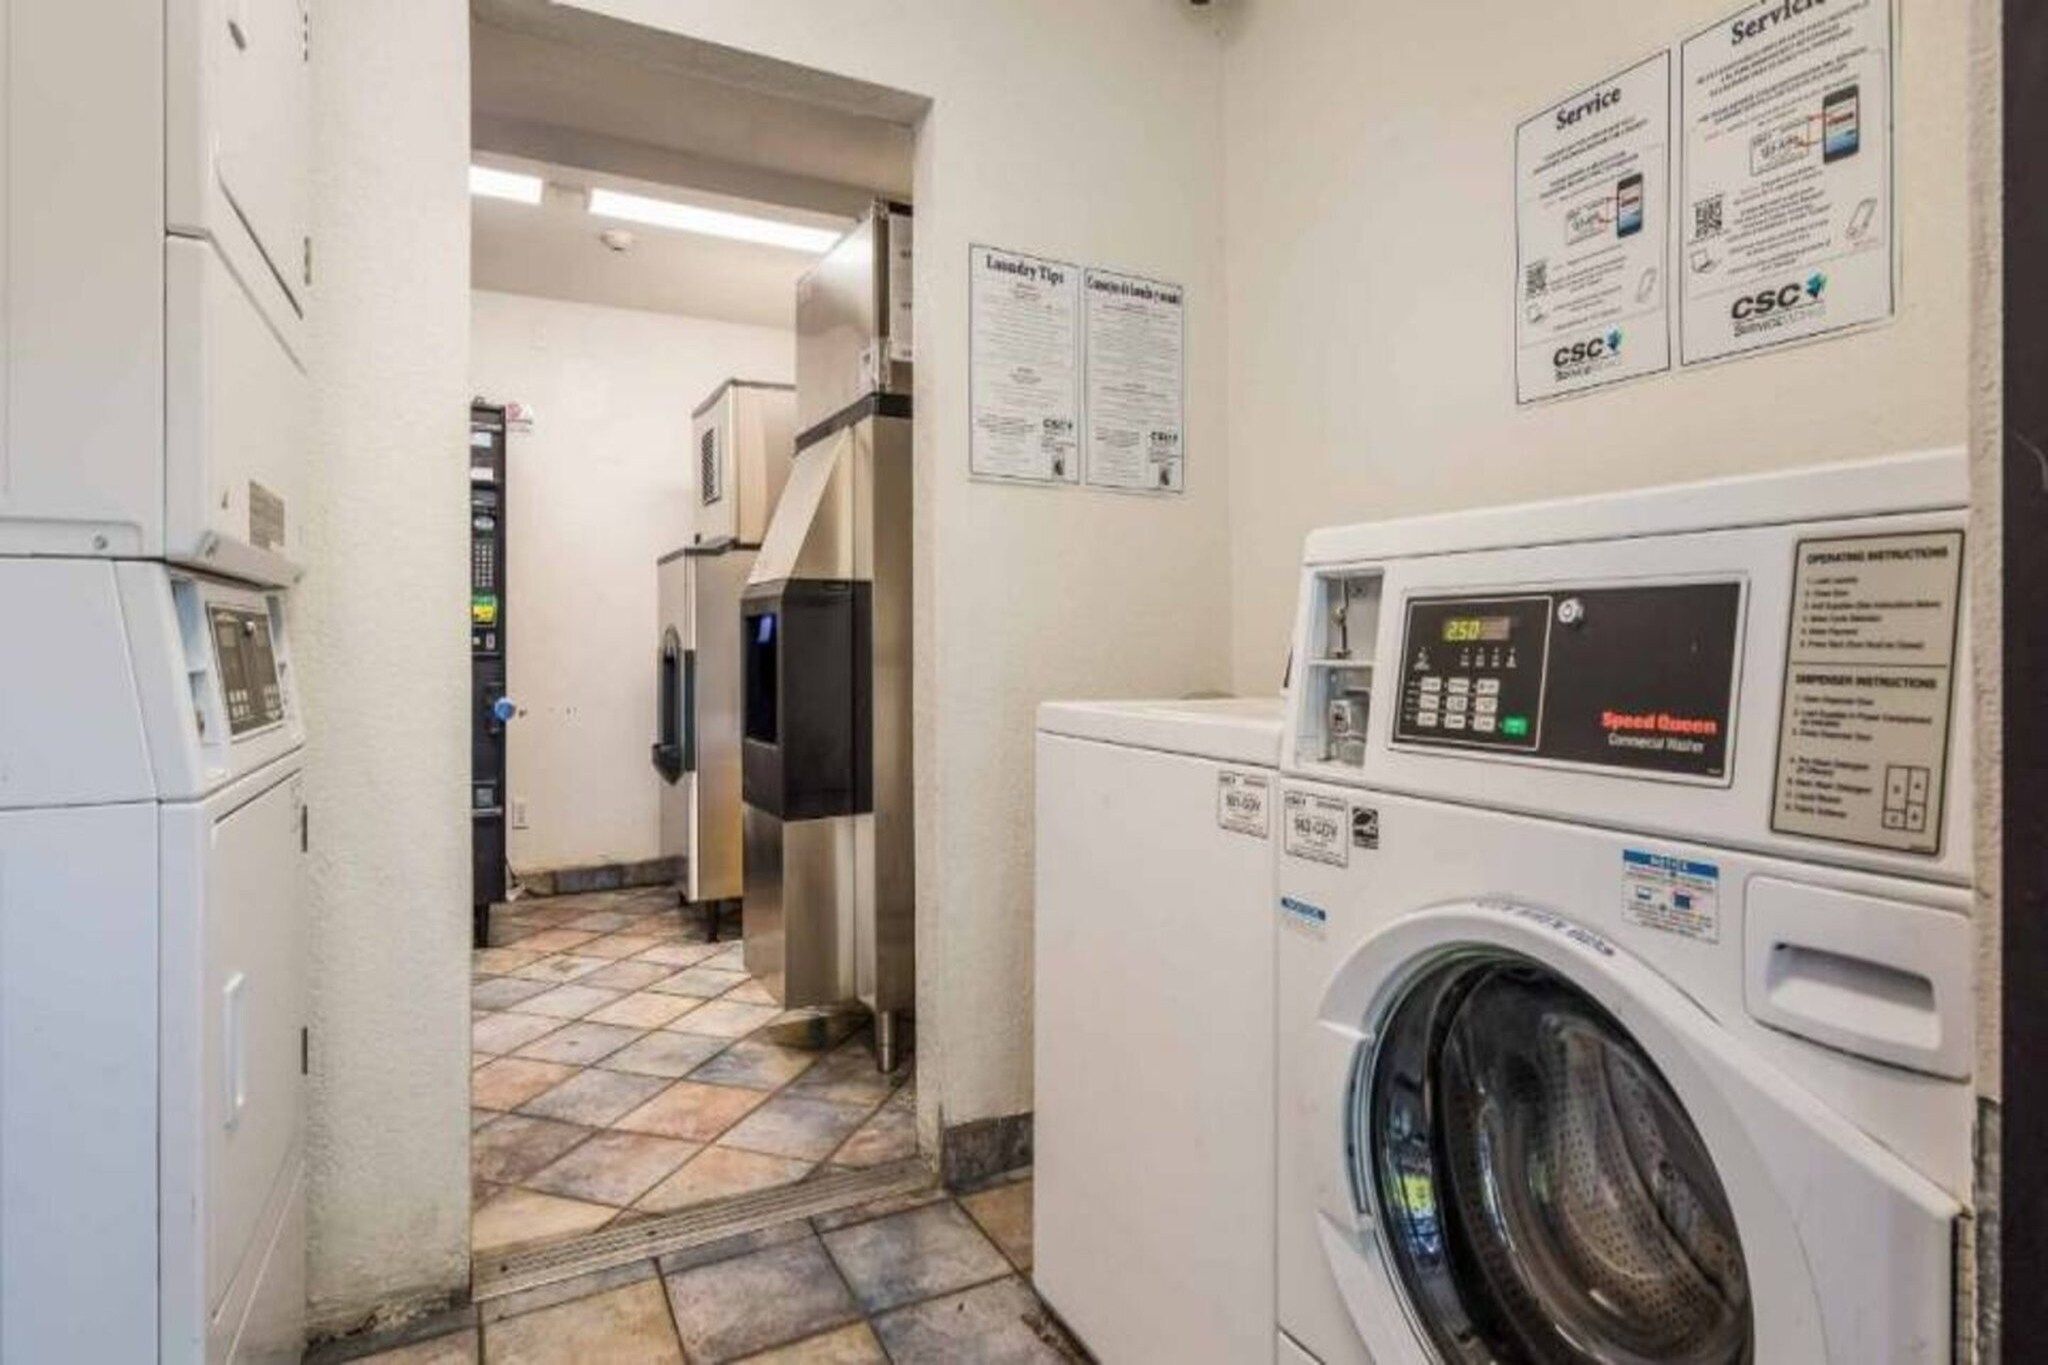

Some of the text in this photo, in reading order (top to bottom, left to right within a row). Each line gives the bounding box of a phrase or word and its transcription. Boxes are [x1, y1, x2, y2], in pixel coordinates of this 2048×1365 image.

[1557, 88, 1621, 130] Service
[986, 254, 1064, 286] Laundry Tips
[1731, 283, 1801, 319] CSC
[1553, 338, 1603, 367] CSC
[1603, 711, 1717, 734] Speed Queen
